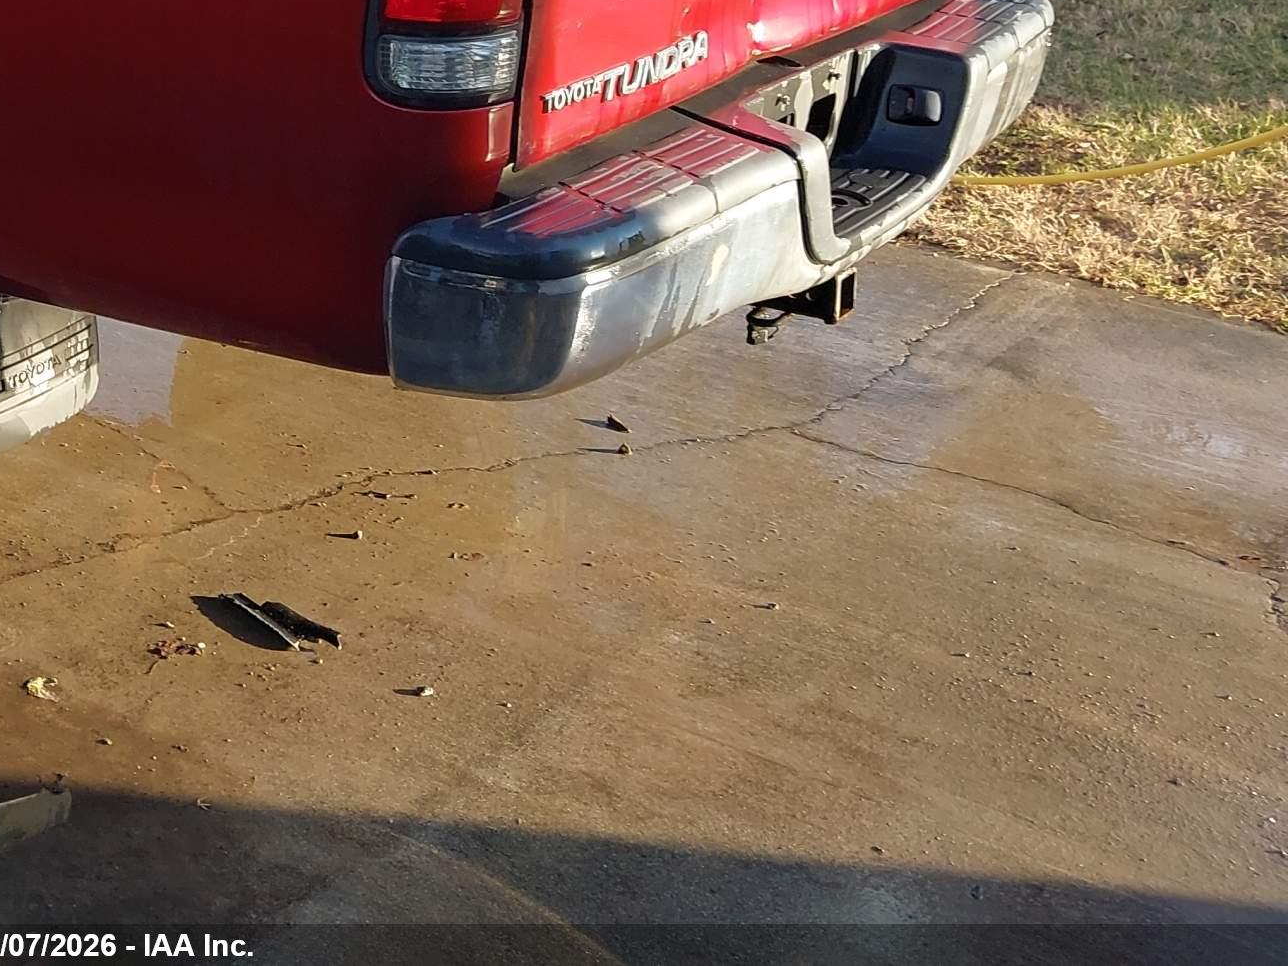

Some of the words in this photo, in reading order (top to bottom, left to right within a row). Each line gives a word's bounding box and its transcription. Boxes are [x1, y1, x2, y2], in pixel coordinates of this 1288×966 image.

[540, 75, 603, 114] TOYOTA
[601, 31, 709, 103] TUNDRA
[9, 354, 62, 387] TOYOTA
